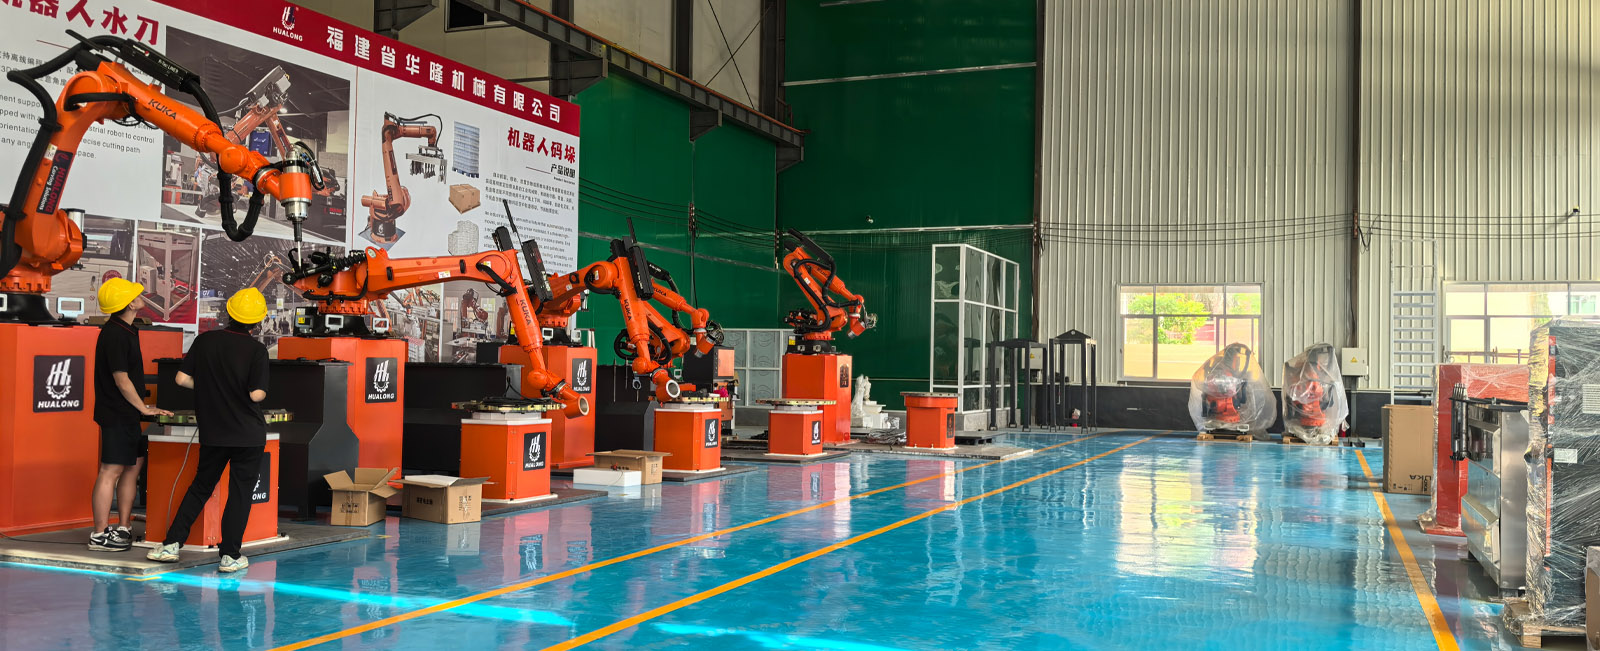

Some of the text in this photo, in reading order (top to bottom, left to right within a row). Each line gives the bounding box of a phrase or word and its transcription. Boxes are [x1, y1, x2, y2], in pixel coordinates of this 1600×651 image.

[0, 0, 159, 45] 器人水刀
[272, 26, 303, 42] HUALONG
[326, 25, 560, 124] 福建省华隆机械有限公司
[18, 98, 43, 108] suppo
[148, 98, 177, 120] KUKA
[20, 111, 36, 121] with
[89, 125, 106, 134] strial
[107, 129, 125, 138] robot
[132, 134, 155, 144] control
[1, 137, 141, 154] any ang ecise cutting path
[77, 150, 97, 159] pace.
[507, 126, 576, 164] 机器人码垛
[46, 165, 59, 186] Carving
[45, 167, 67, 213] HUALONG
[520, 298, 532, 326] KUKA
[623, 298, 633, 321] KUKA
[37, 400, 80, 409] HUALONG
[252, 492, 267, 501] ONG
